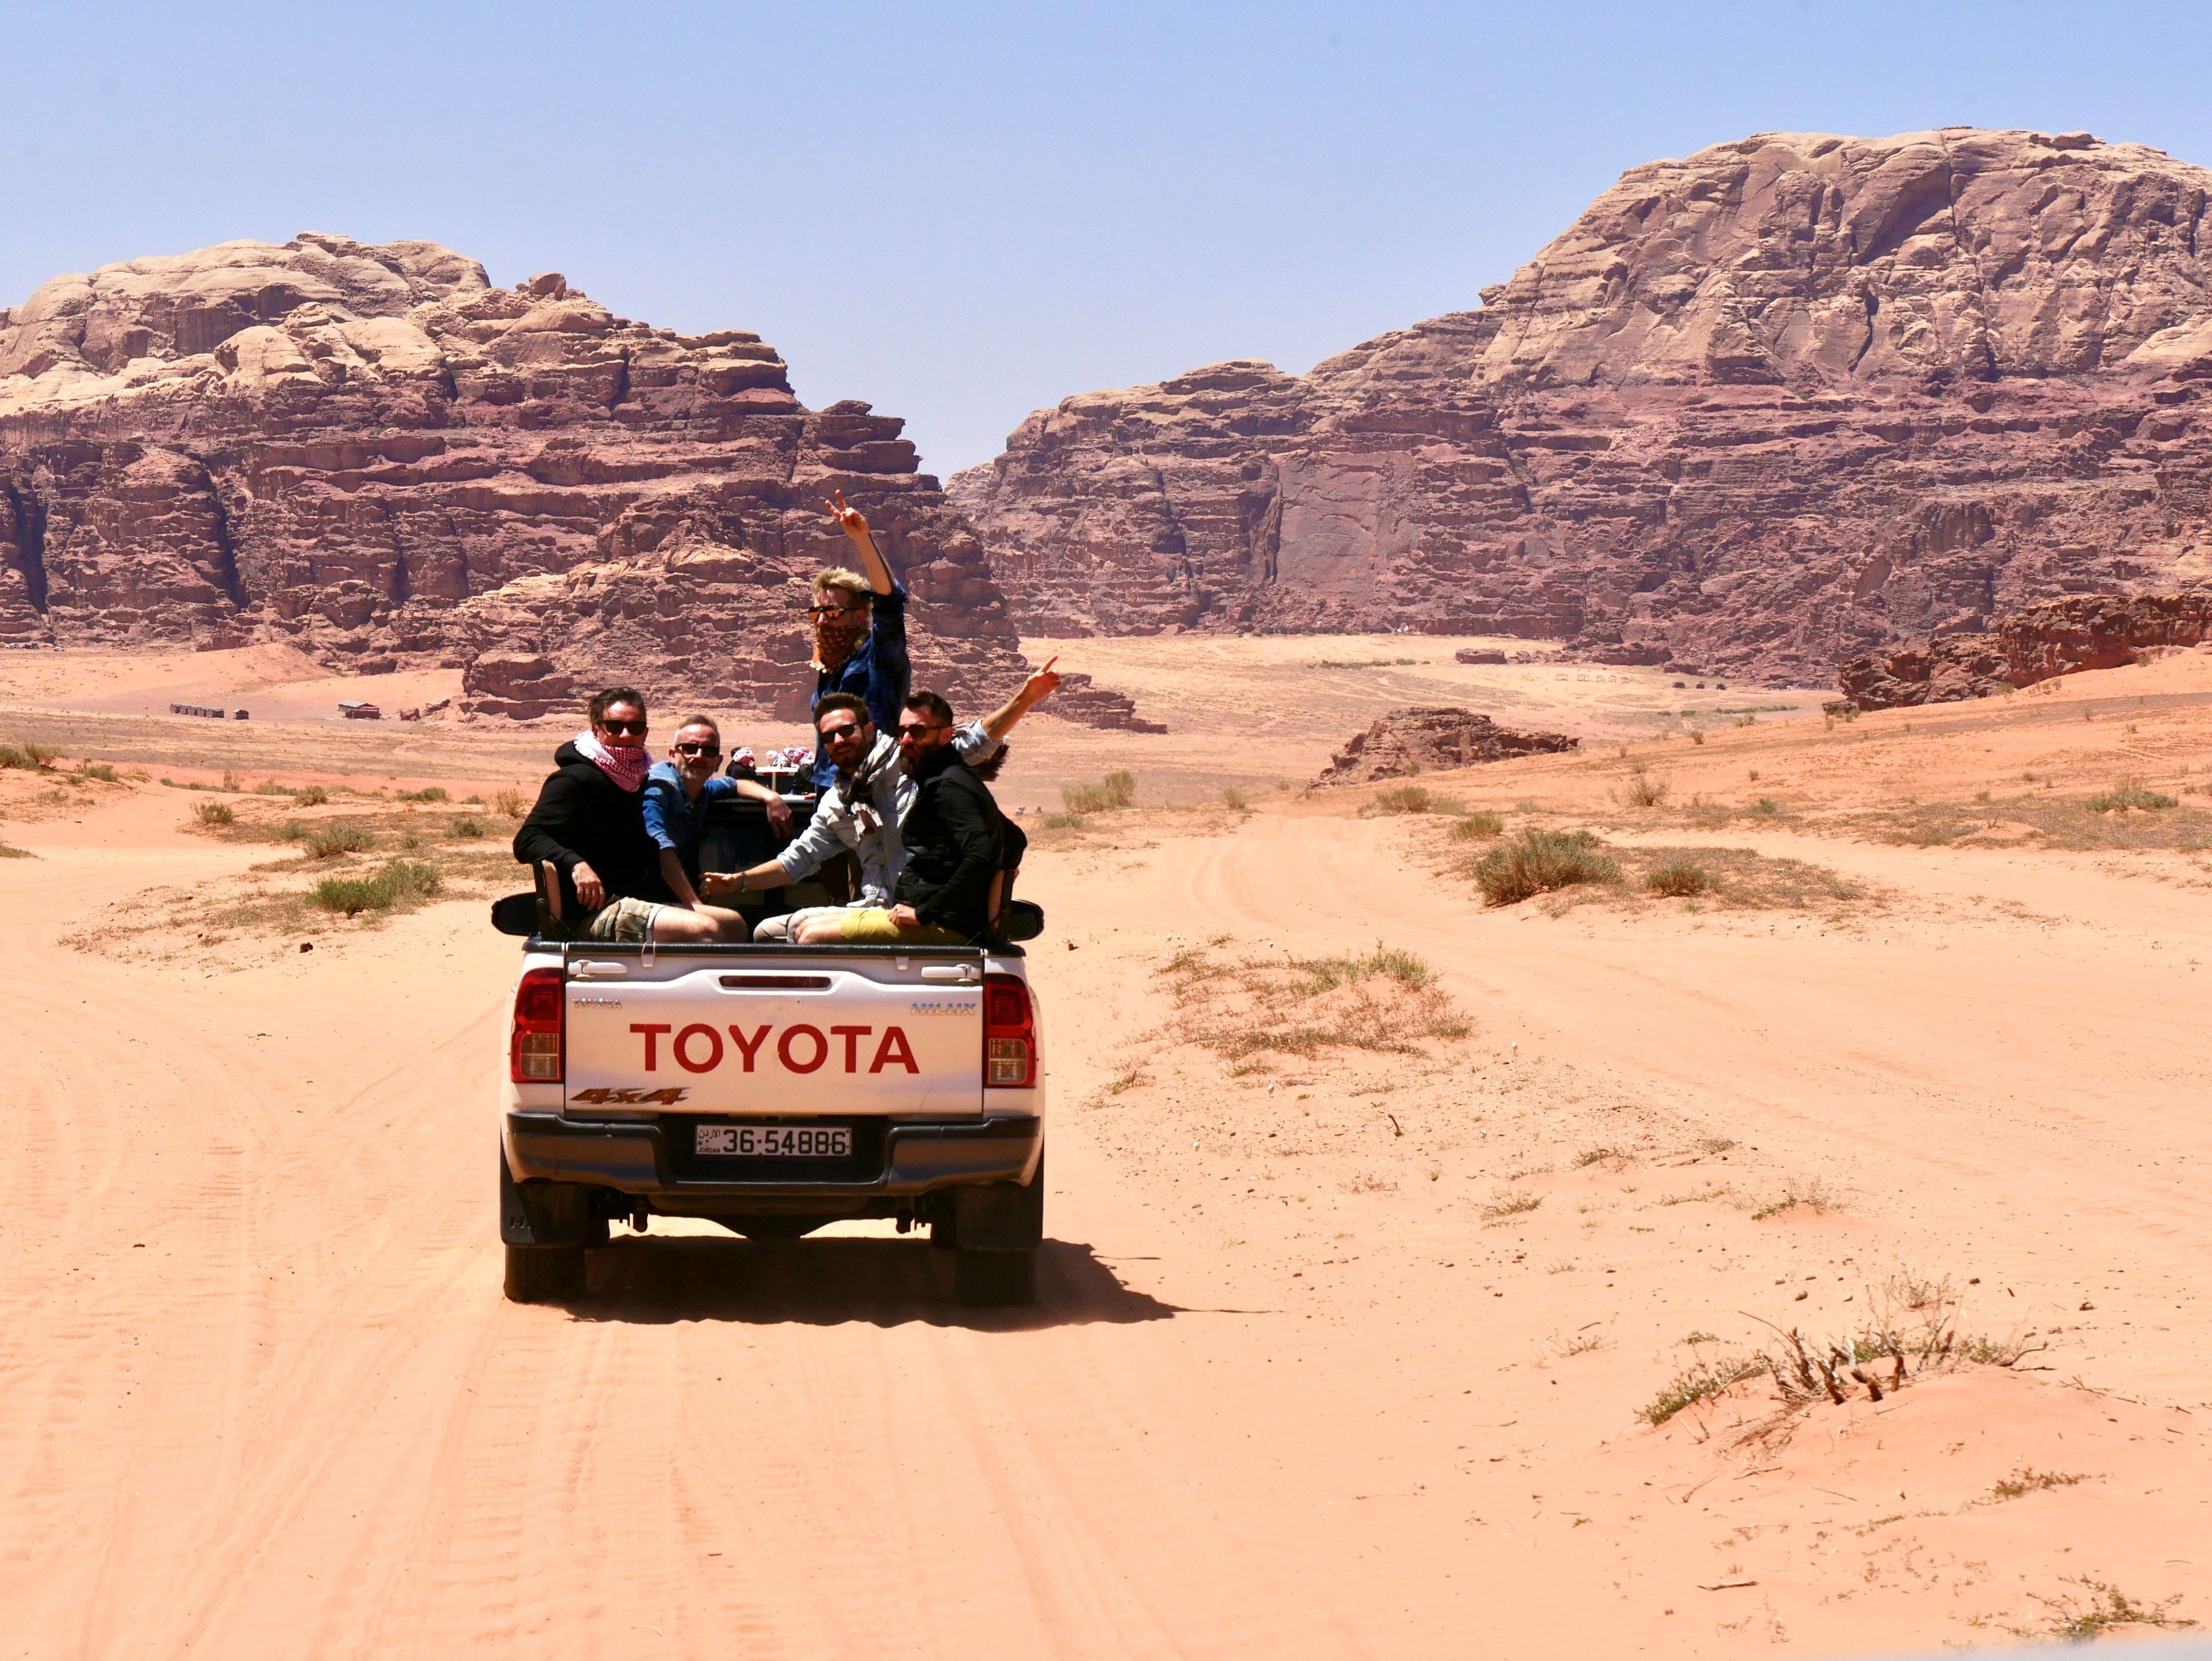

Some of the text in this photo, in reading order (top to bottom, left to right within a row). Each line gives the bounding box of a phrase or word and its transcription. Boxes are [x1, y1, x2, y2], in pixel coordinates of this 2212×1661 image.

[571, 997, 622, 1009] TOYOTA
[910, 1002, 977, 1015] HILUX
[630, 1023, 920, 1074] TOYOTA
